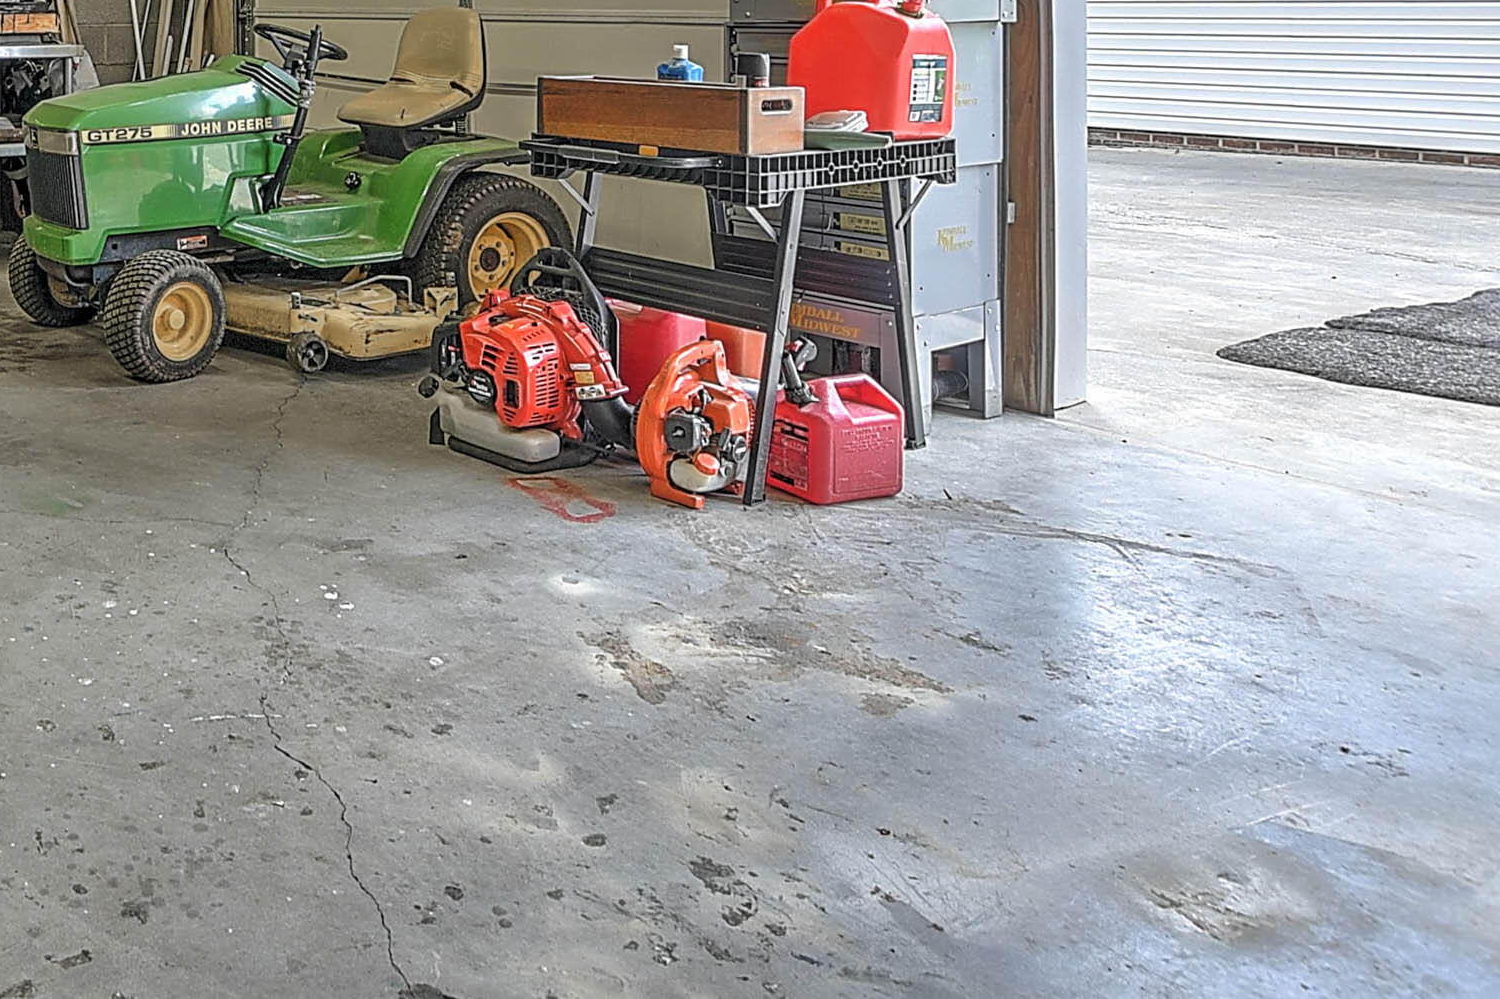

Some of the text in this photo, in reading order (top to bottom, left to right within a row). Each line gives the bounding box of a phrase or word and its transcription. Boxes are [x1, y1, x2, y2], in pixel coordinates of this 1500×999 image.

[87, 117, 274, 143] GT275 JOHN DEERE
